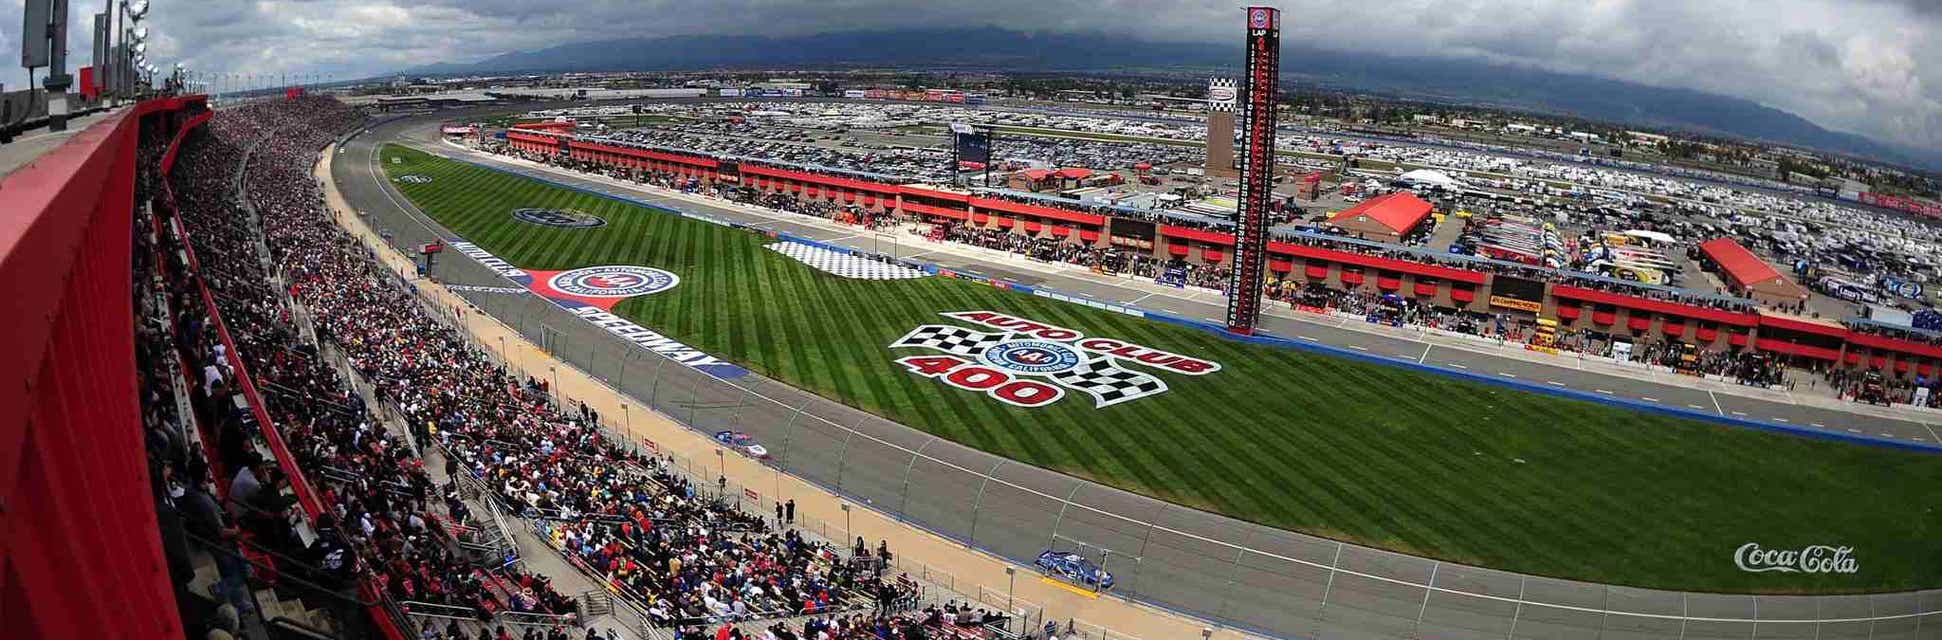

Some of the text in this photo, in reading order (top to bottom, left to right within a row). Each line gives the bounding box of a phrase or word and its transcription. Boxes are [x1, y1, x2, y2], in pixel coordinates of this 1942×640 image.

[568, 305, 732, 368] SPEEDWAY
[942, 311, 1218, 374] AUTO CLUB
[897, 355, 1062, 406] 400
[1734, 542, 1860, 573] Coca Cola
